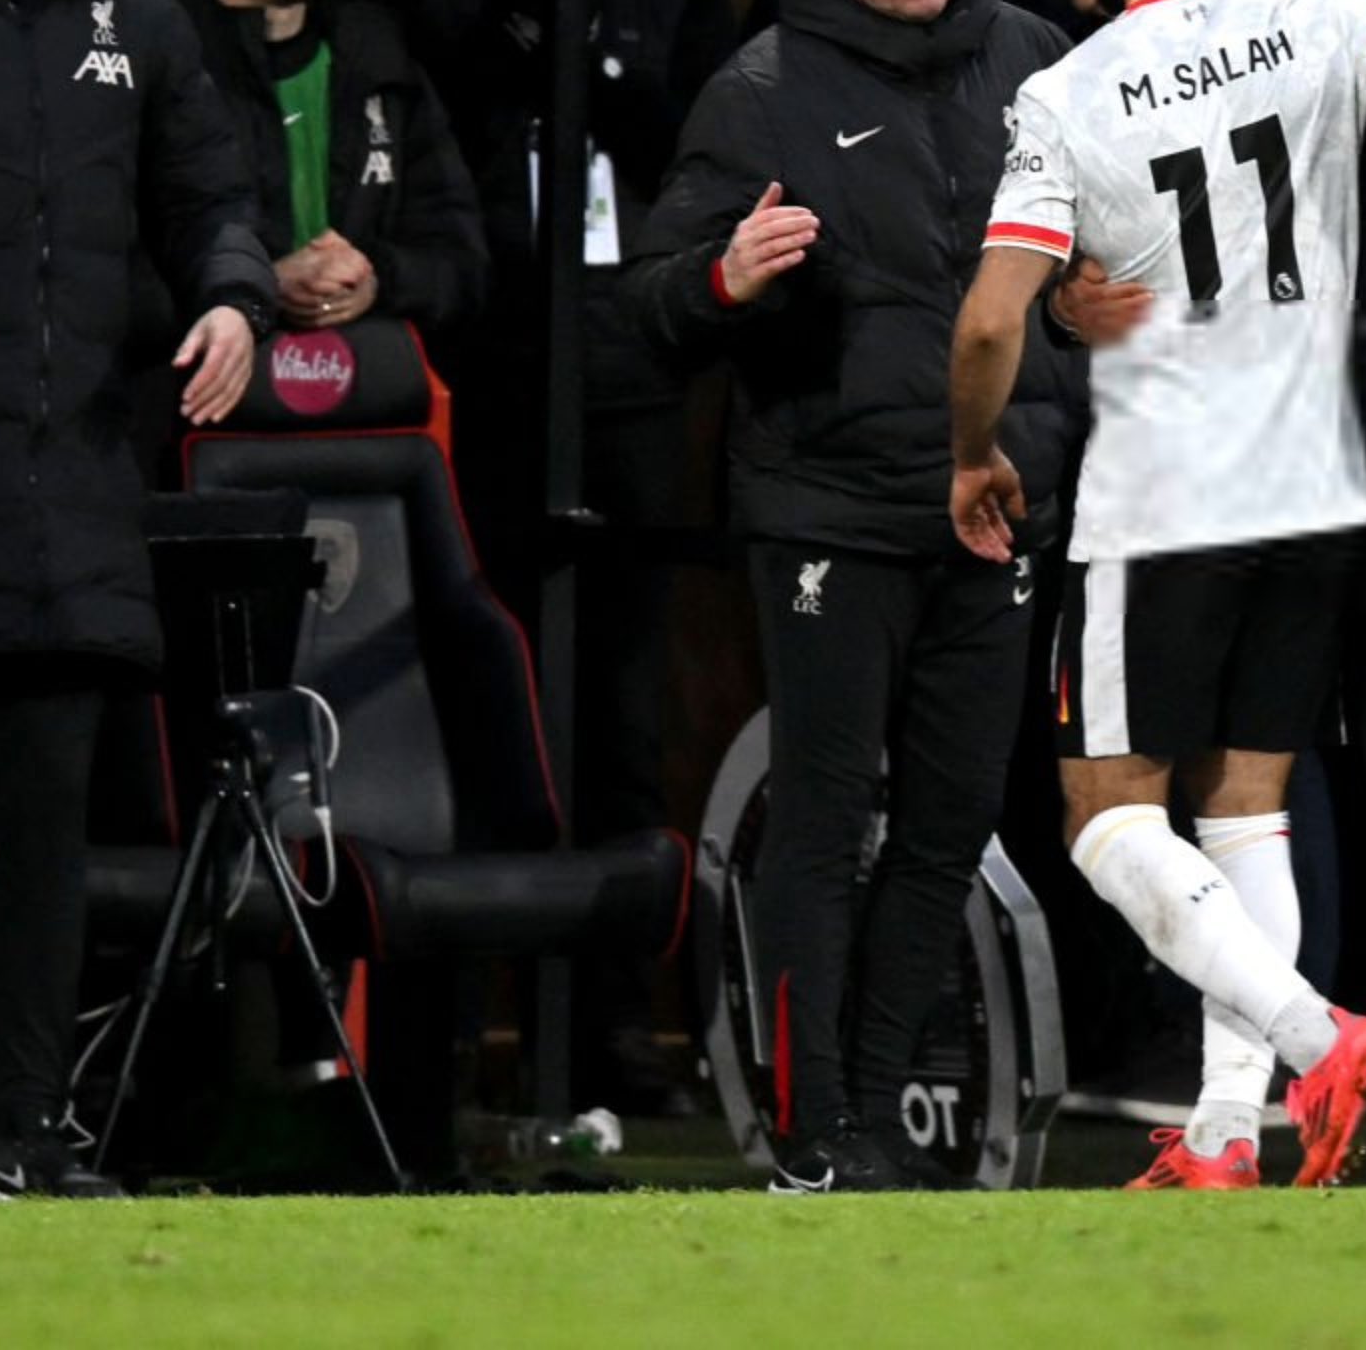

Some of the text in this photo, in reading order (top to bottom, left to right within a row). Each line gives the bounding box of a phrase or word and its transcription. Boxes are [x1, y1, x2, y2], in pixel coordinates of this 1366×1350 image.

[72, 50, 135, 90] AXA
[1148, 114, 1305, 320] 11
[271, 344, 353, 393] Vitality
